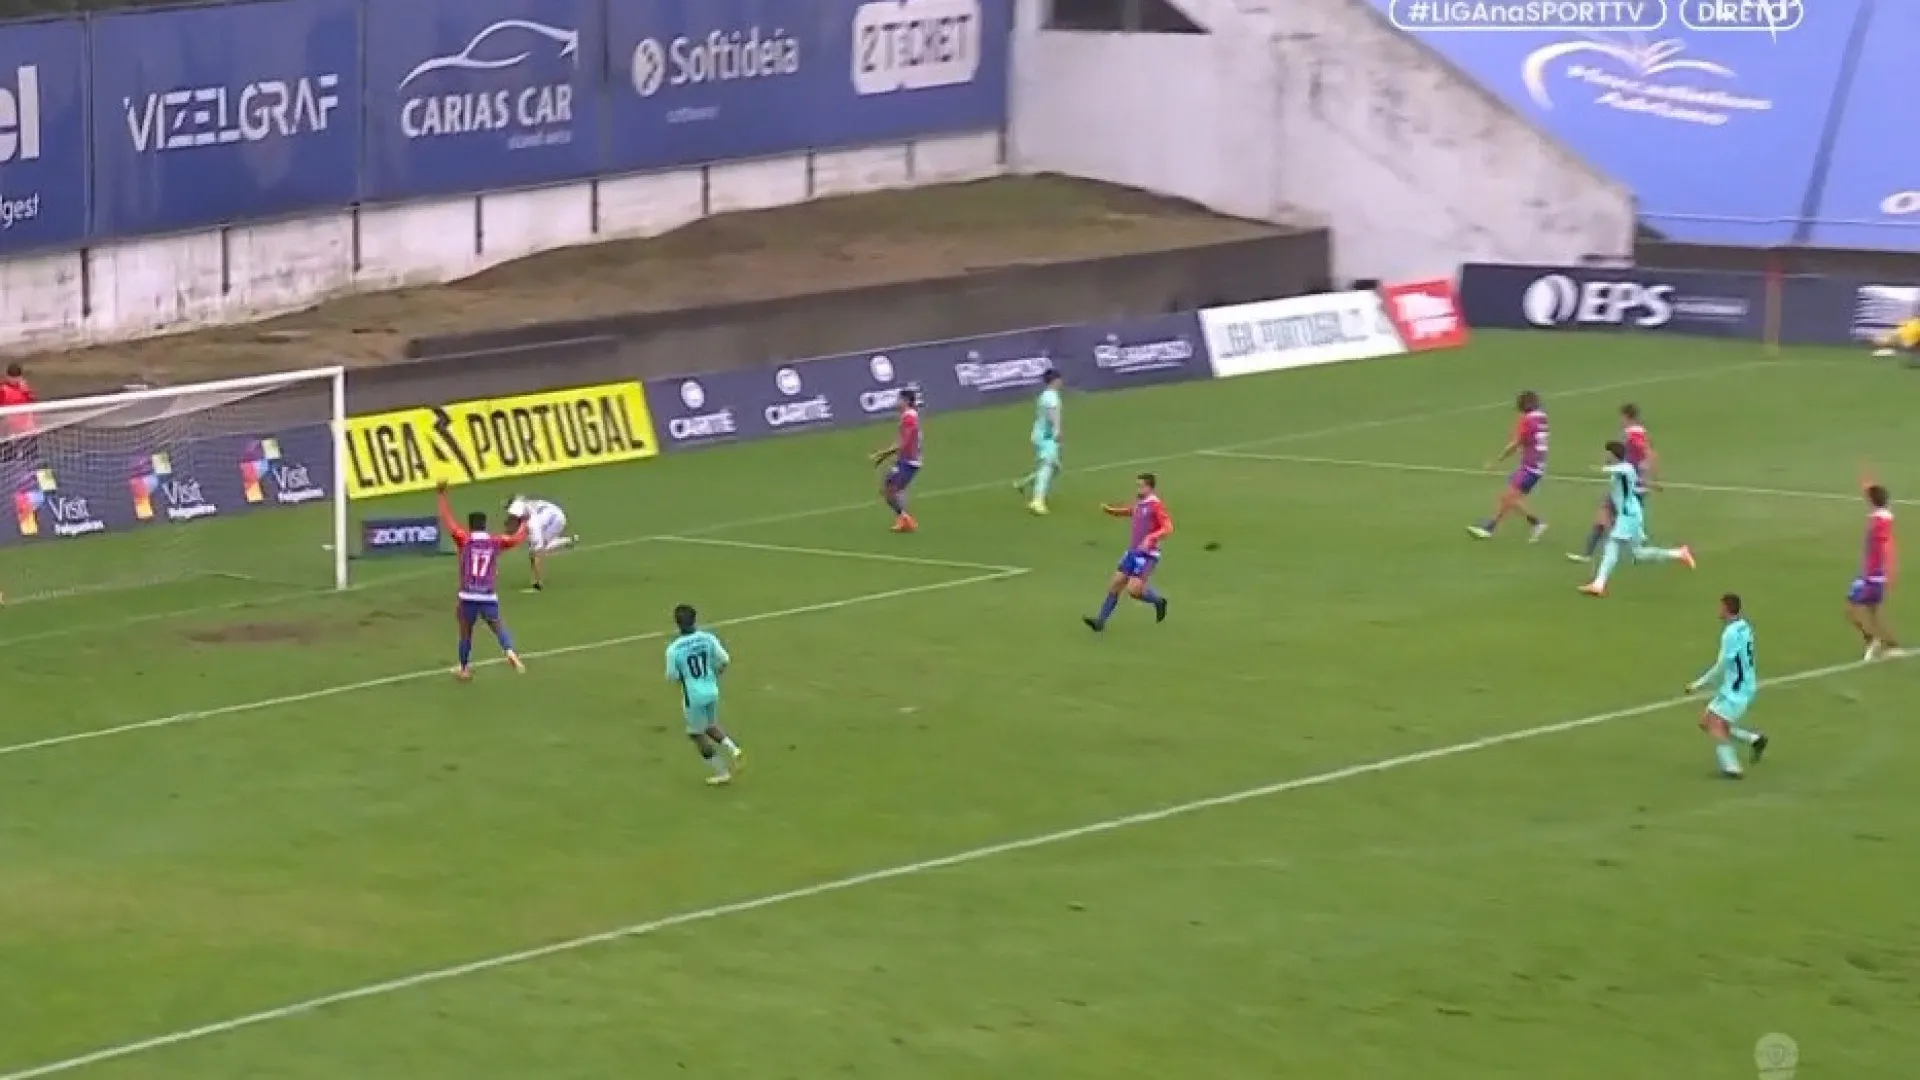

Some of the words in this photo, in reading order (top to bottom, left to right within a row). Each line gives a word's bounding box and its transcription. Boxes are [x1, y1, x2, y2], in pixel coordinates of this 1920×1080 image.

[123, 73, 338, 151] VIZELGRAF
[402, 90, 510, 138] CARIAS
[518, 84, 573, 126] CAR
[1577, 281, 1676, 326] EPS
[346, 423, 429, 488] LIGA
[467, 395, 645, 471] PORTUGAL
[471, 551, 491, 577] 17
